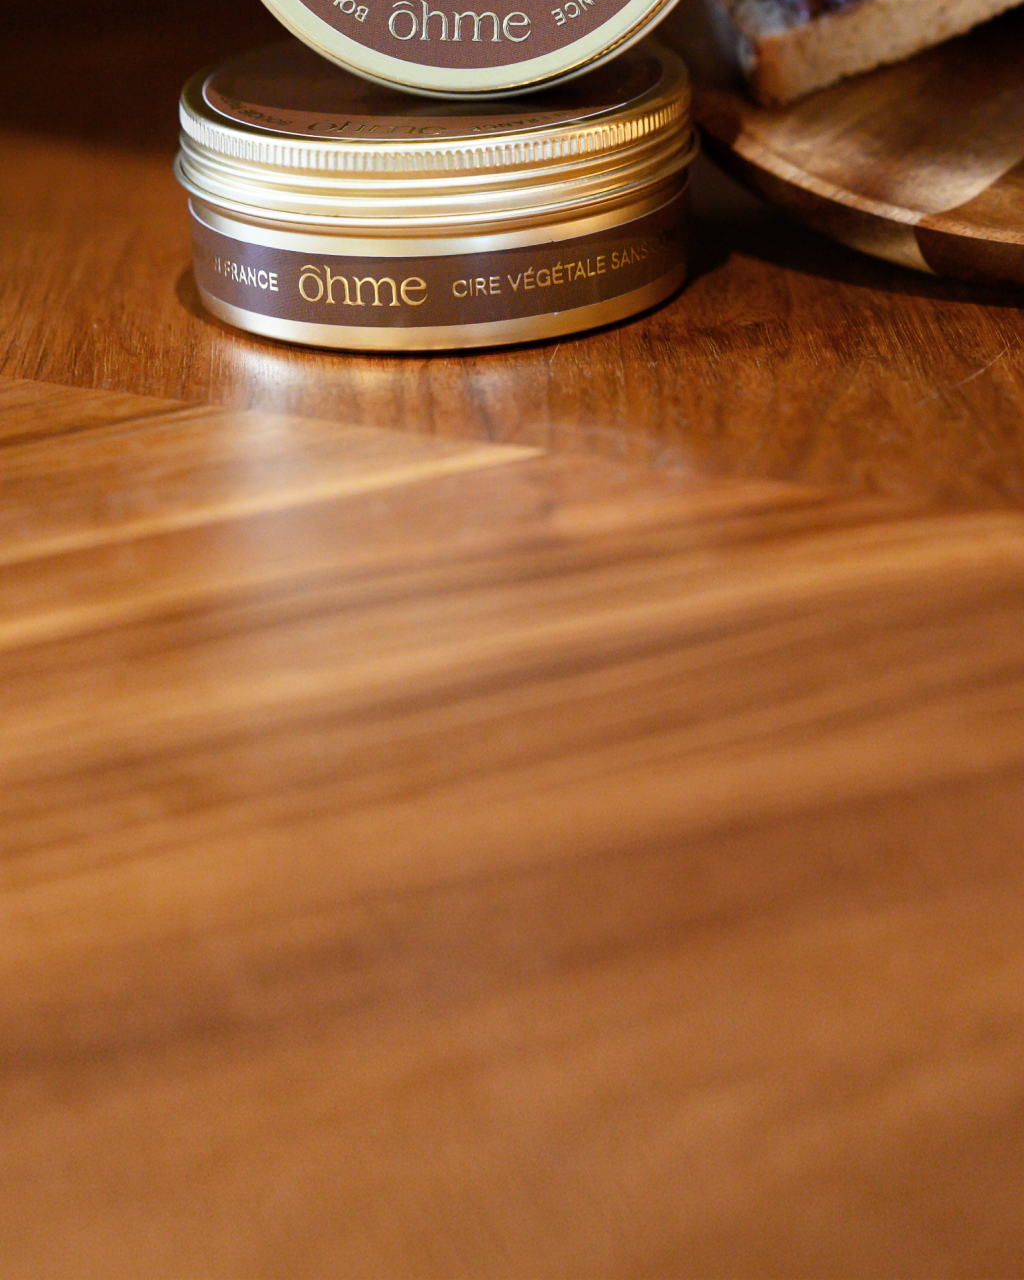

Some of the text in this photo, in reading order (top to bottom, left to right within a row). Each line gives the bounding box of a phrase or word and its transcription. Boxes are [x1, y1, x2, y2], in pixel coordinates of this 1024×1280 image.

[388, 0, 532, 43] ôhme
[224, 260, 280, 292] FRANCE
[298, 264, 429, 307] ôhme
[452, 240, 649, 298] CIRE VÉGÉTALE SANS
